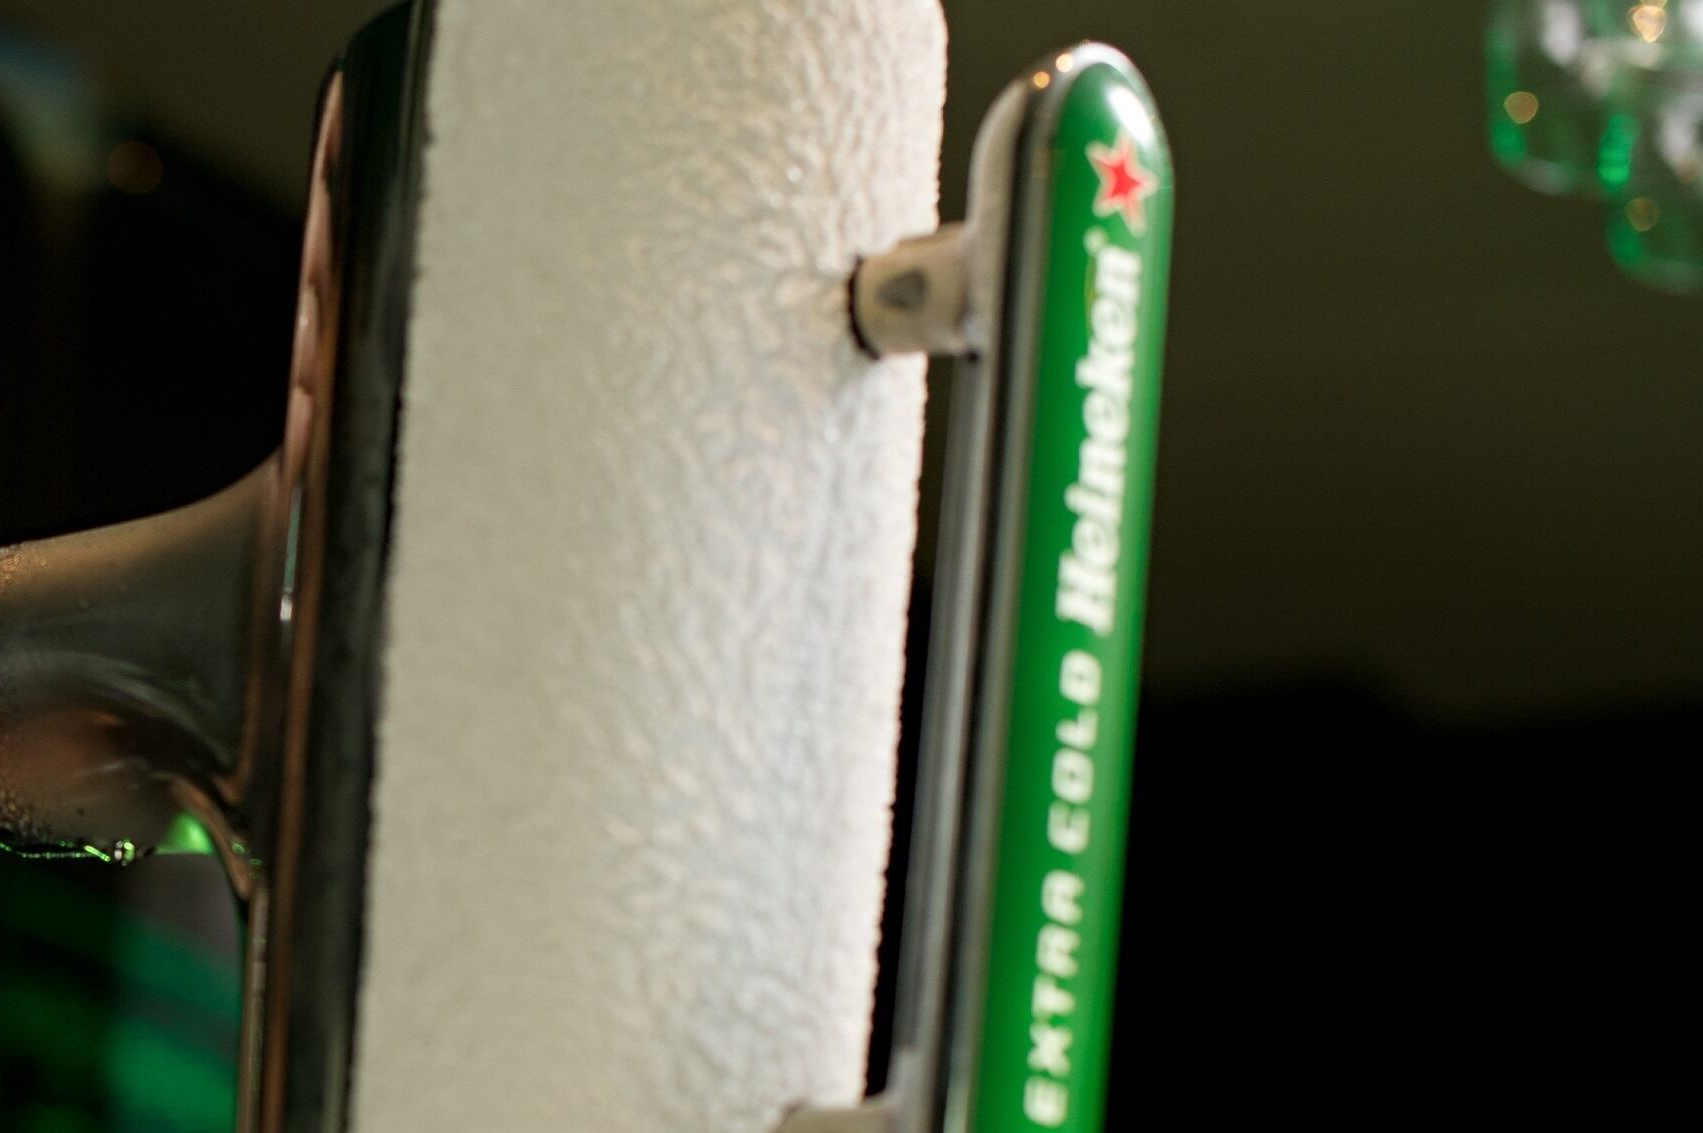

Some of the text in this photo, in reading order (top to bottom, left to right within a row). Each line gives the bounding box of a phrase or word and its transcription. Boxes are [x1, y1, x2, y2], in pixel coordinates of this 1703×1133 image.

[1055, 242, 1142, 638] Heineken
[1048, 649, 1103, 854] COLD
[1024, 869, 1085, 1126] EXTRA
